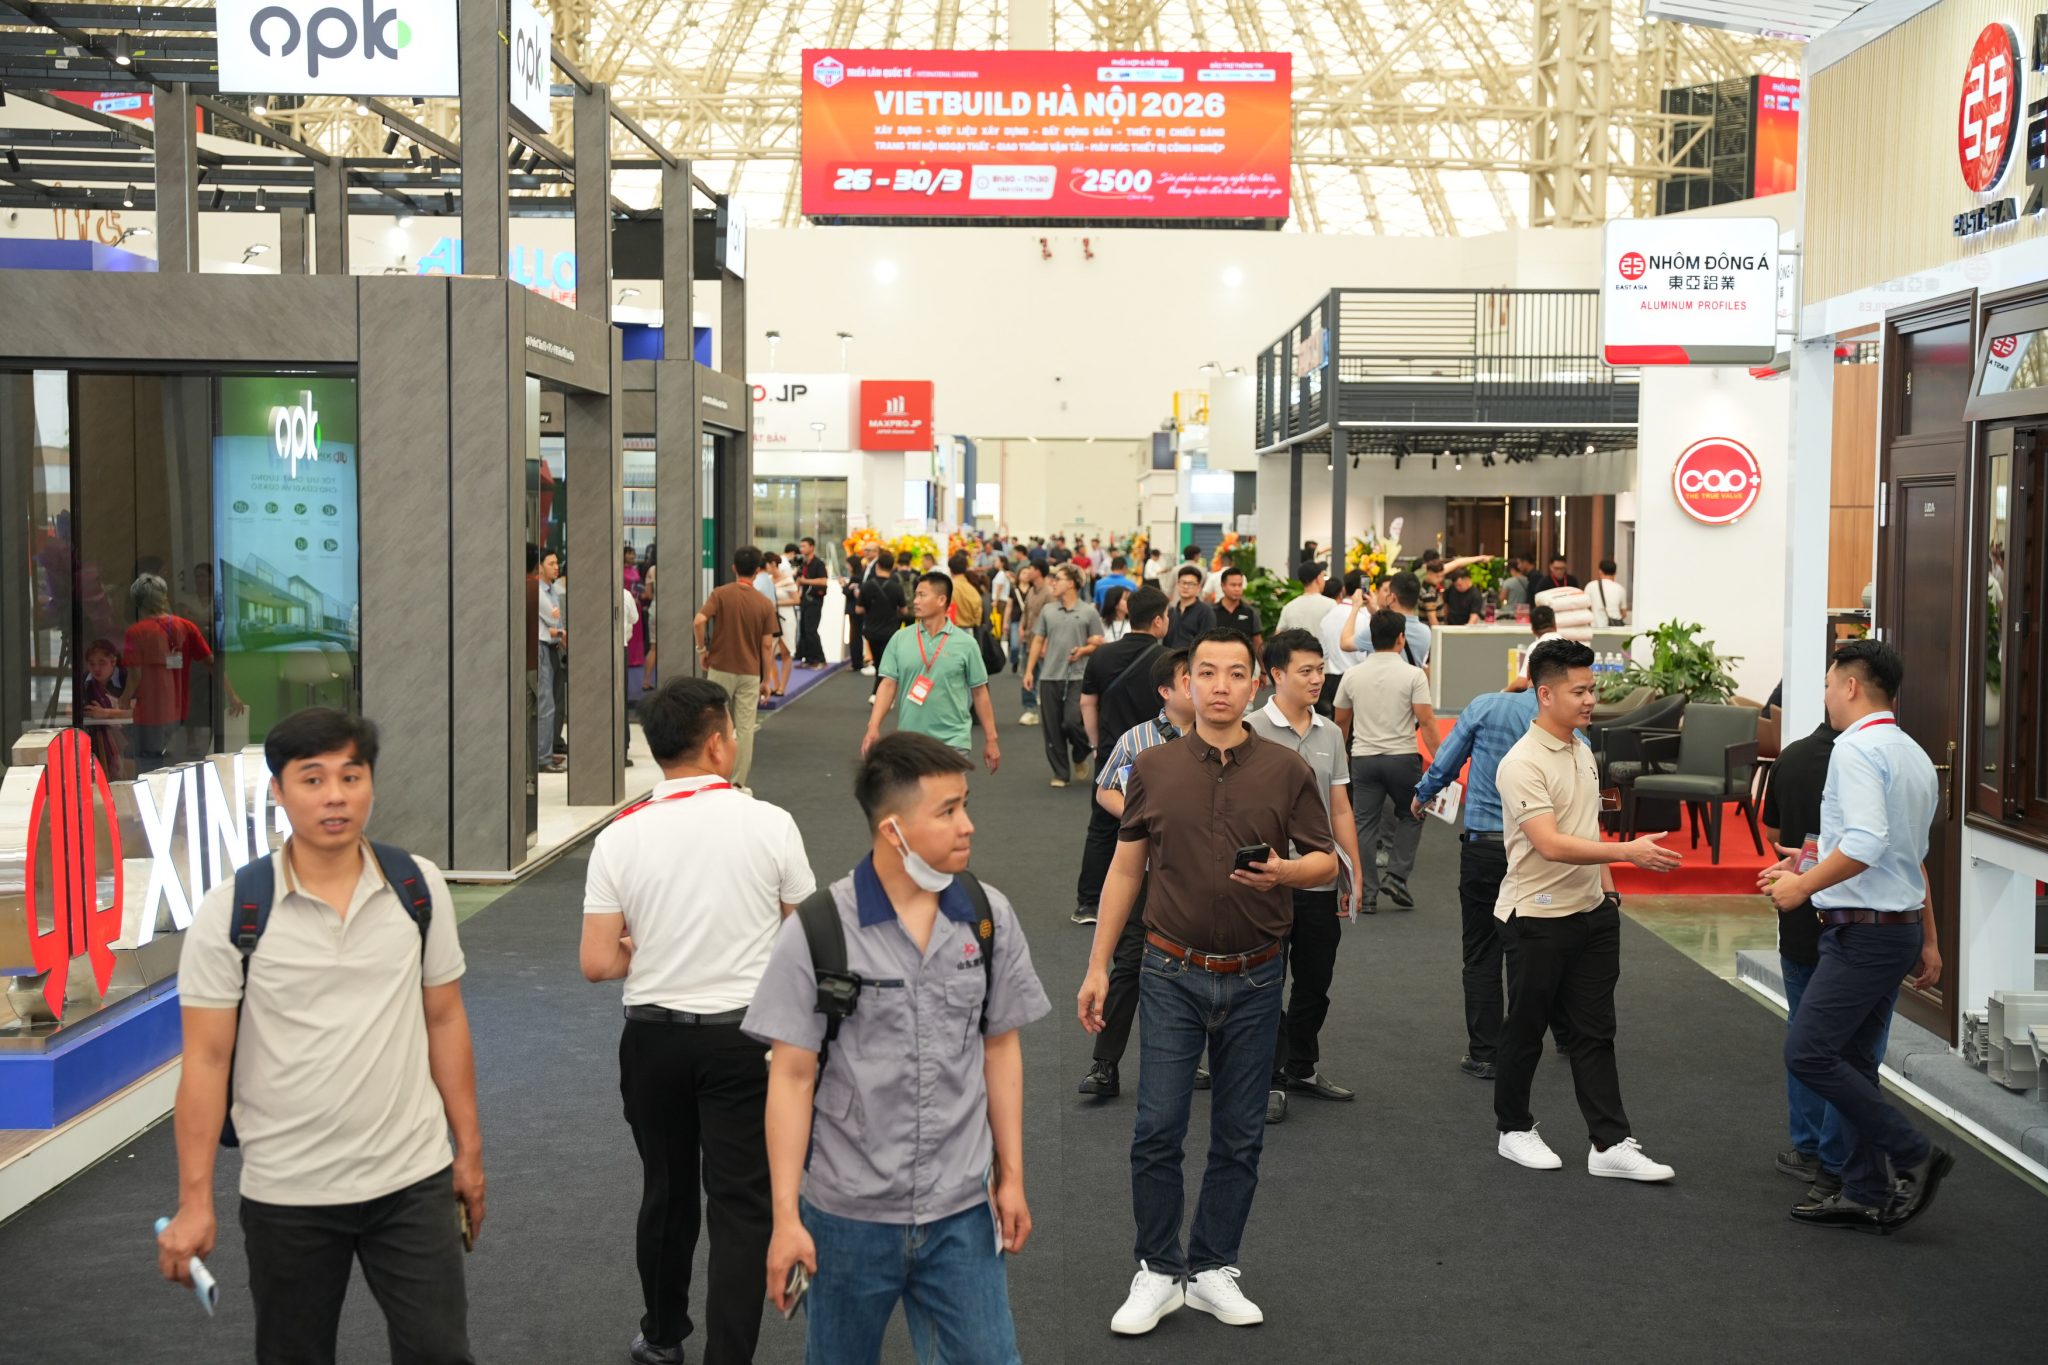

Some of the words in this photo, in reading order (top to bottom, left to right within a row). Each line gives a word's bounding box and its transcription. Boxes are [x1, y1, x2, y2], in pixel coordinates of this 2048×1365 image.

[874, 90, 1032, 116] VIETBUILD
[1037, 83, 1079, 117] HÀ
[1084, 84, 1137, 125] NỘI
[1141, 92, 1226, 118] 2026
[834, 168, 873, 191] 26
[893, 168, 963, 196] 30/3
[1081, 168, 1153, 193] 2500
[1649, 251, 1700, 270] NHÔM
[1704, 251, 1754, 271] ĐÔNG
[1757, 252, 1769, 270] Á
[1669, 275, 1736, 291] 東亞鋁業
[1640, 300, 1693, 310] ALUMINUM
[1698, 300, 1747, 310] PROFILES
